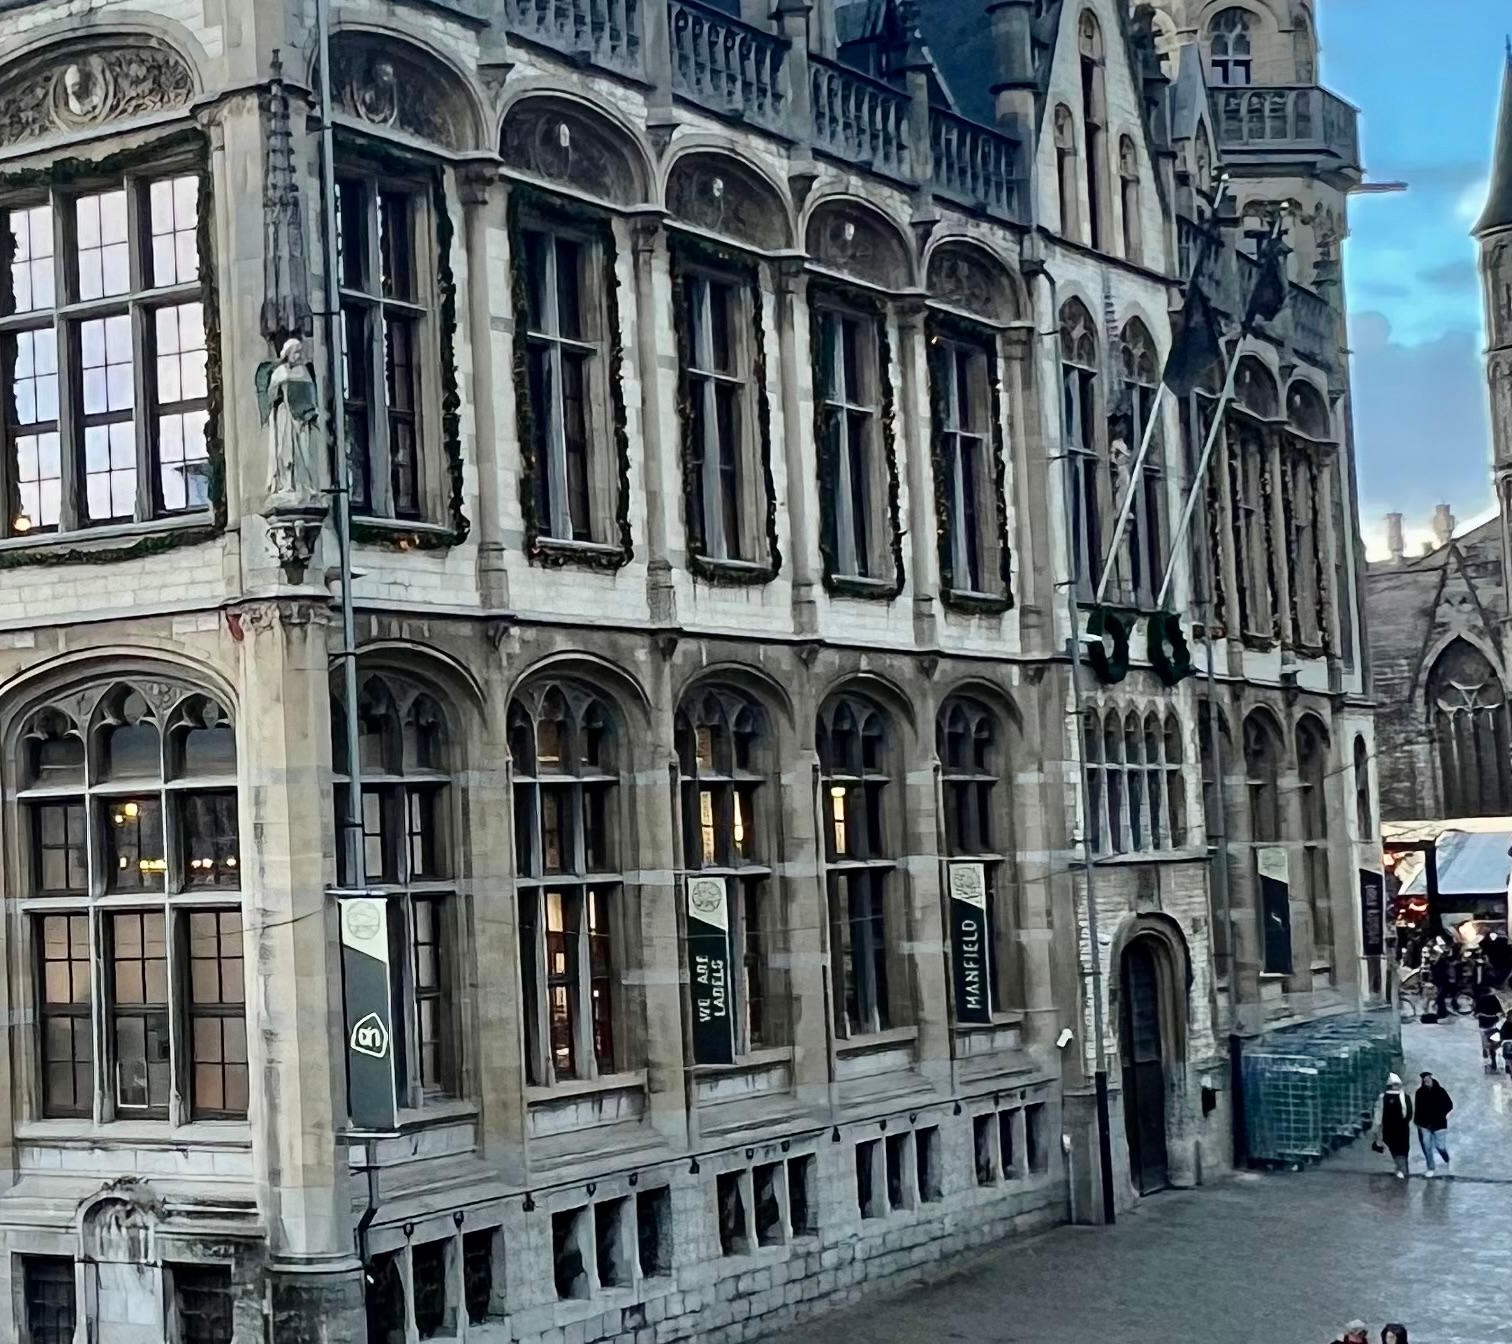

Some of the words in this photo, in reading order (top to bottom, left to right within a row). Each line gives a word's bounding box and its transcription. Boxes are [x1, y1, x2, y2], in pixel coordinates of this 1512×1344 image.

[695, 955, 709, 984] ARE
[961, 919, 982, 1010] MANFIELD
[711, 959, 726, 1017] LABELS
[697, 998, 711, 1023] WE
